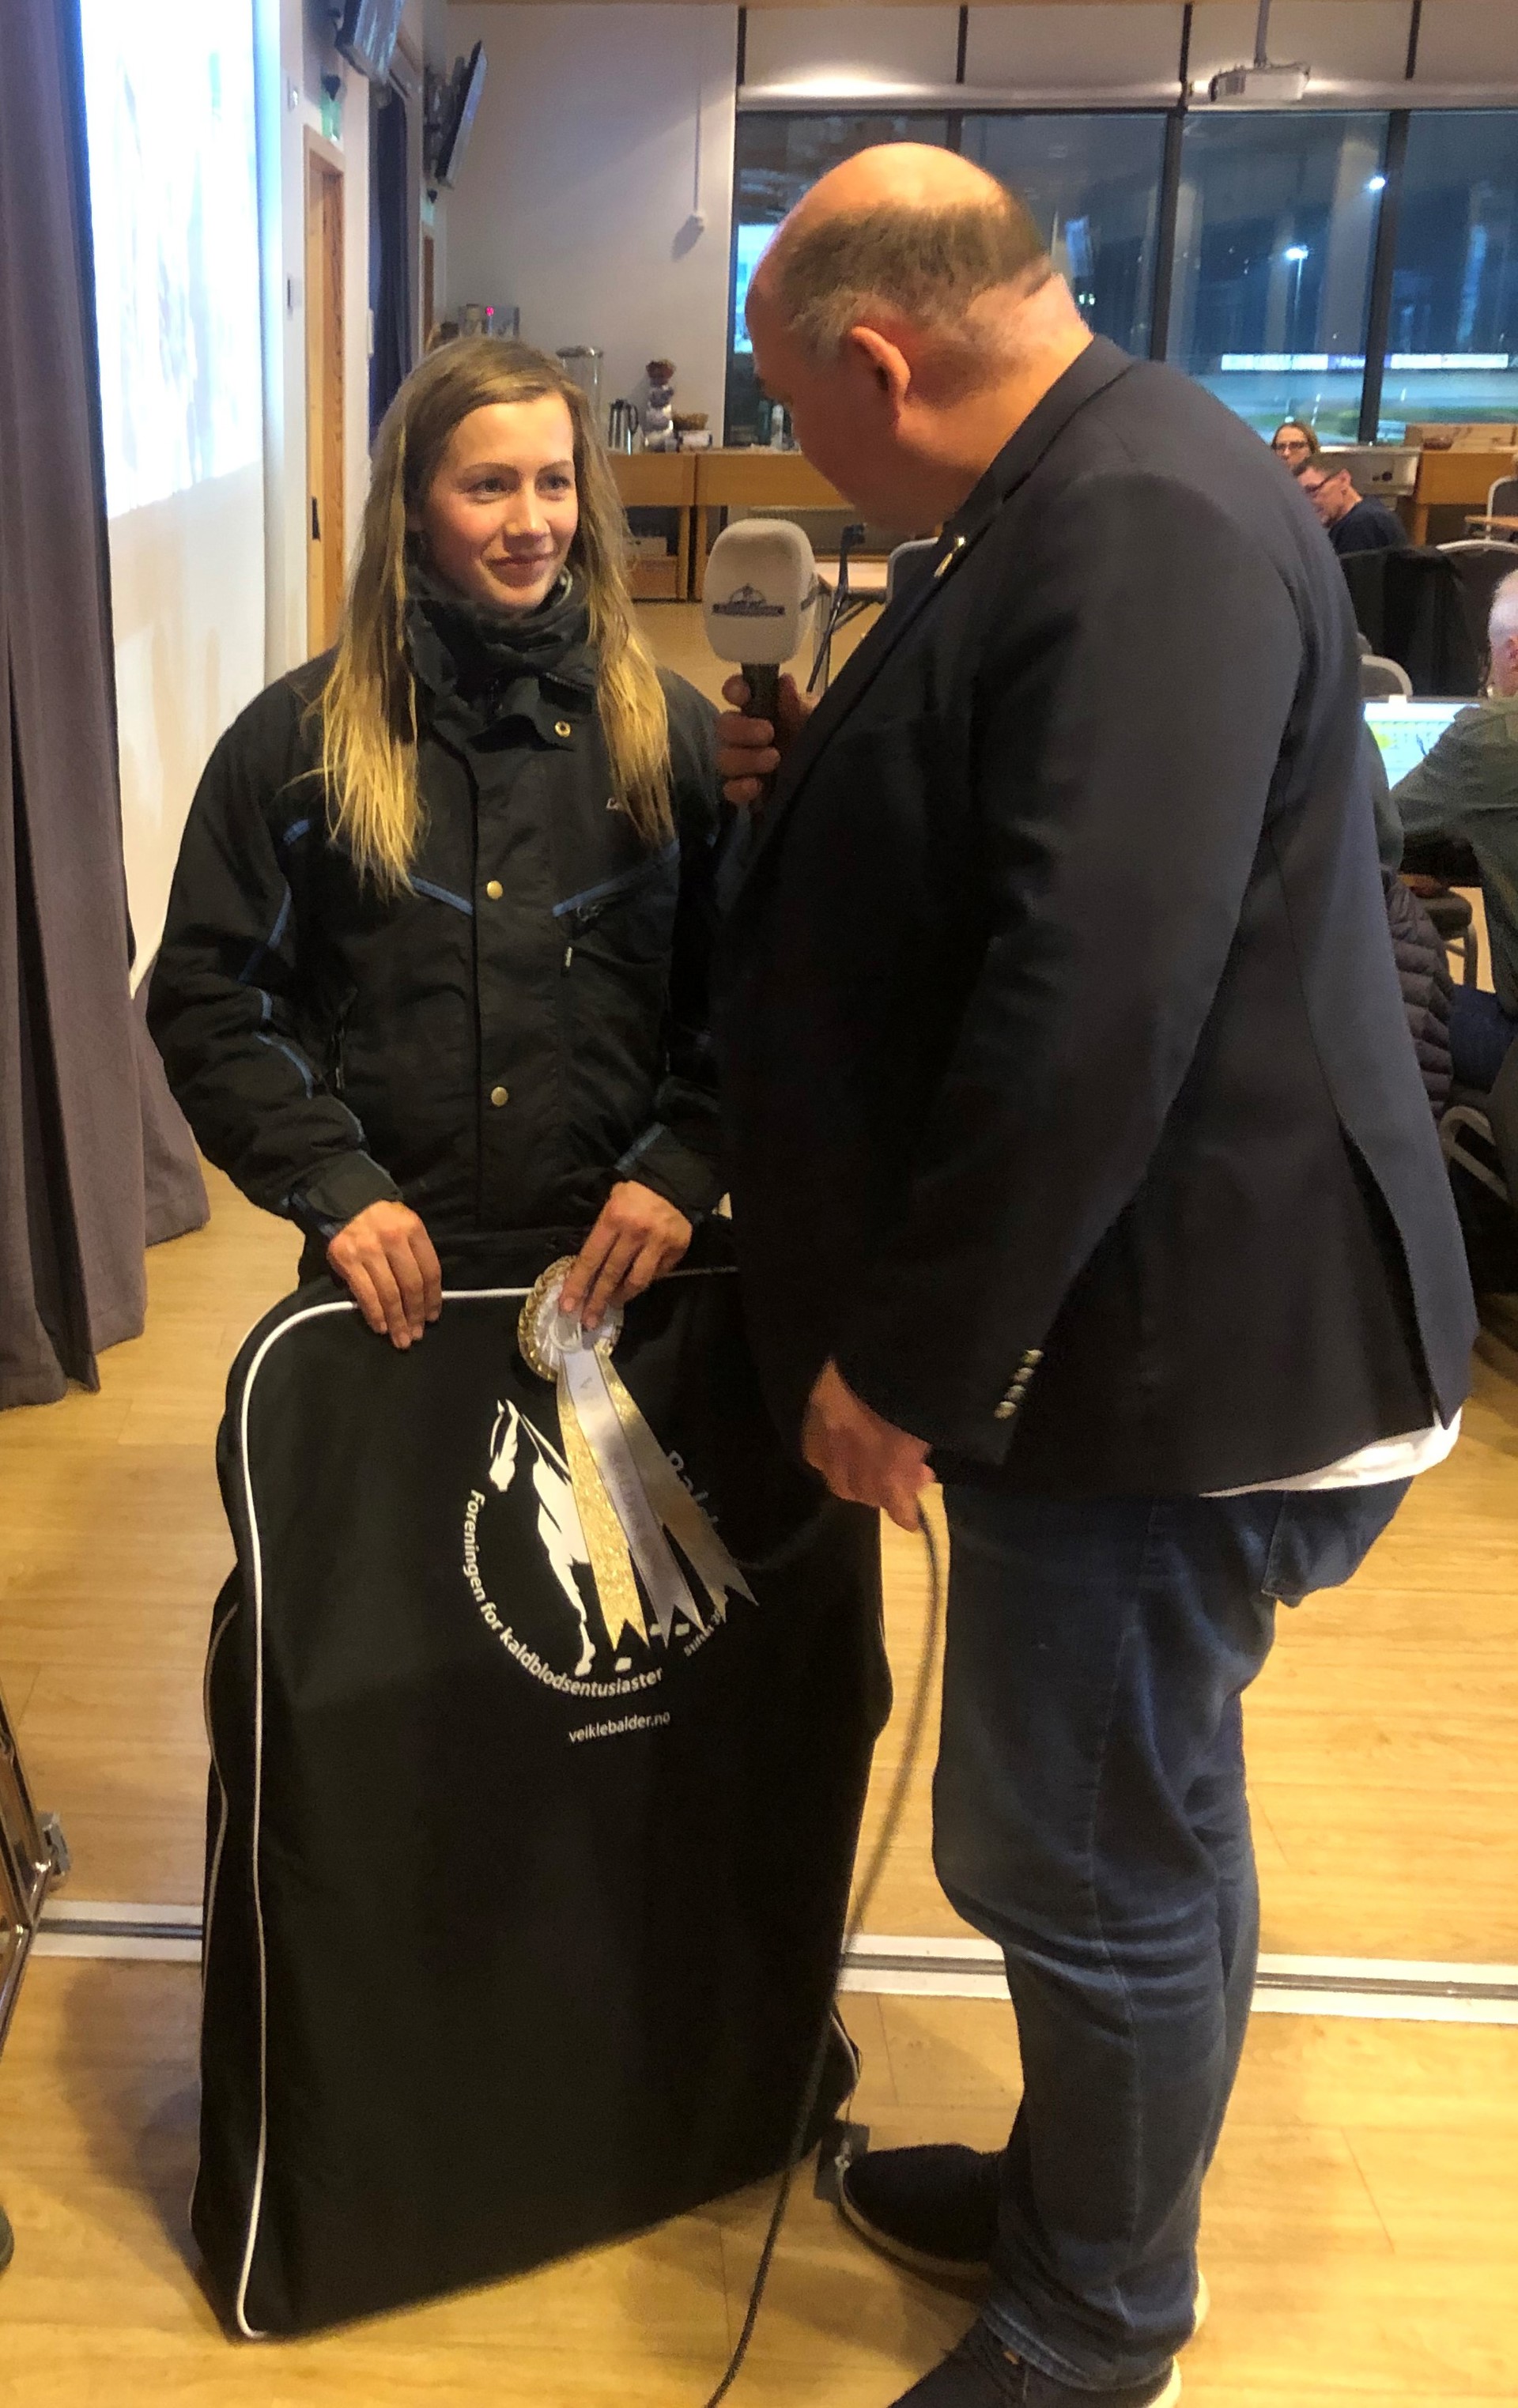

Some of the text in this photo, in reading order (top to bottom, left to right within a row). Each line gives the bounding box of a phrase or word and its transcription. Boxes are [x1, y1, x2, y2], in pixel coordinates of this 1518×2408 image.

[463, 1489, 663, 1697] Foreningen for kaldblodsentusiaster
[568, 1712, 670, 1744] veiklebalder.no
